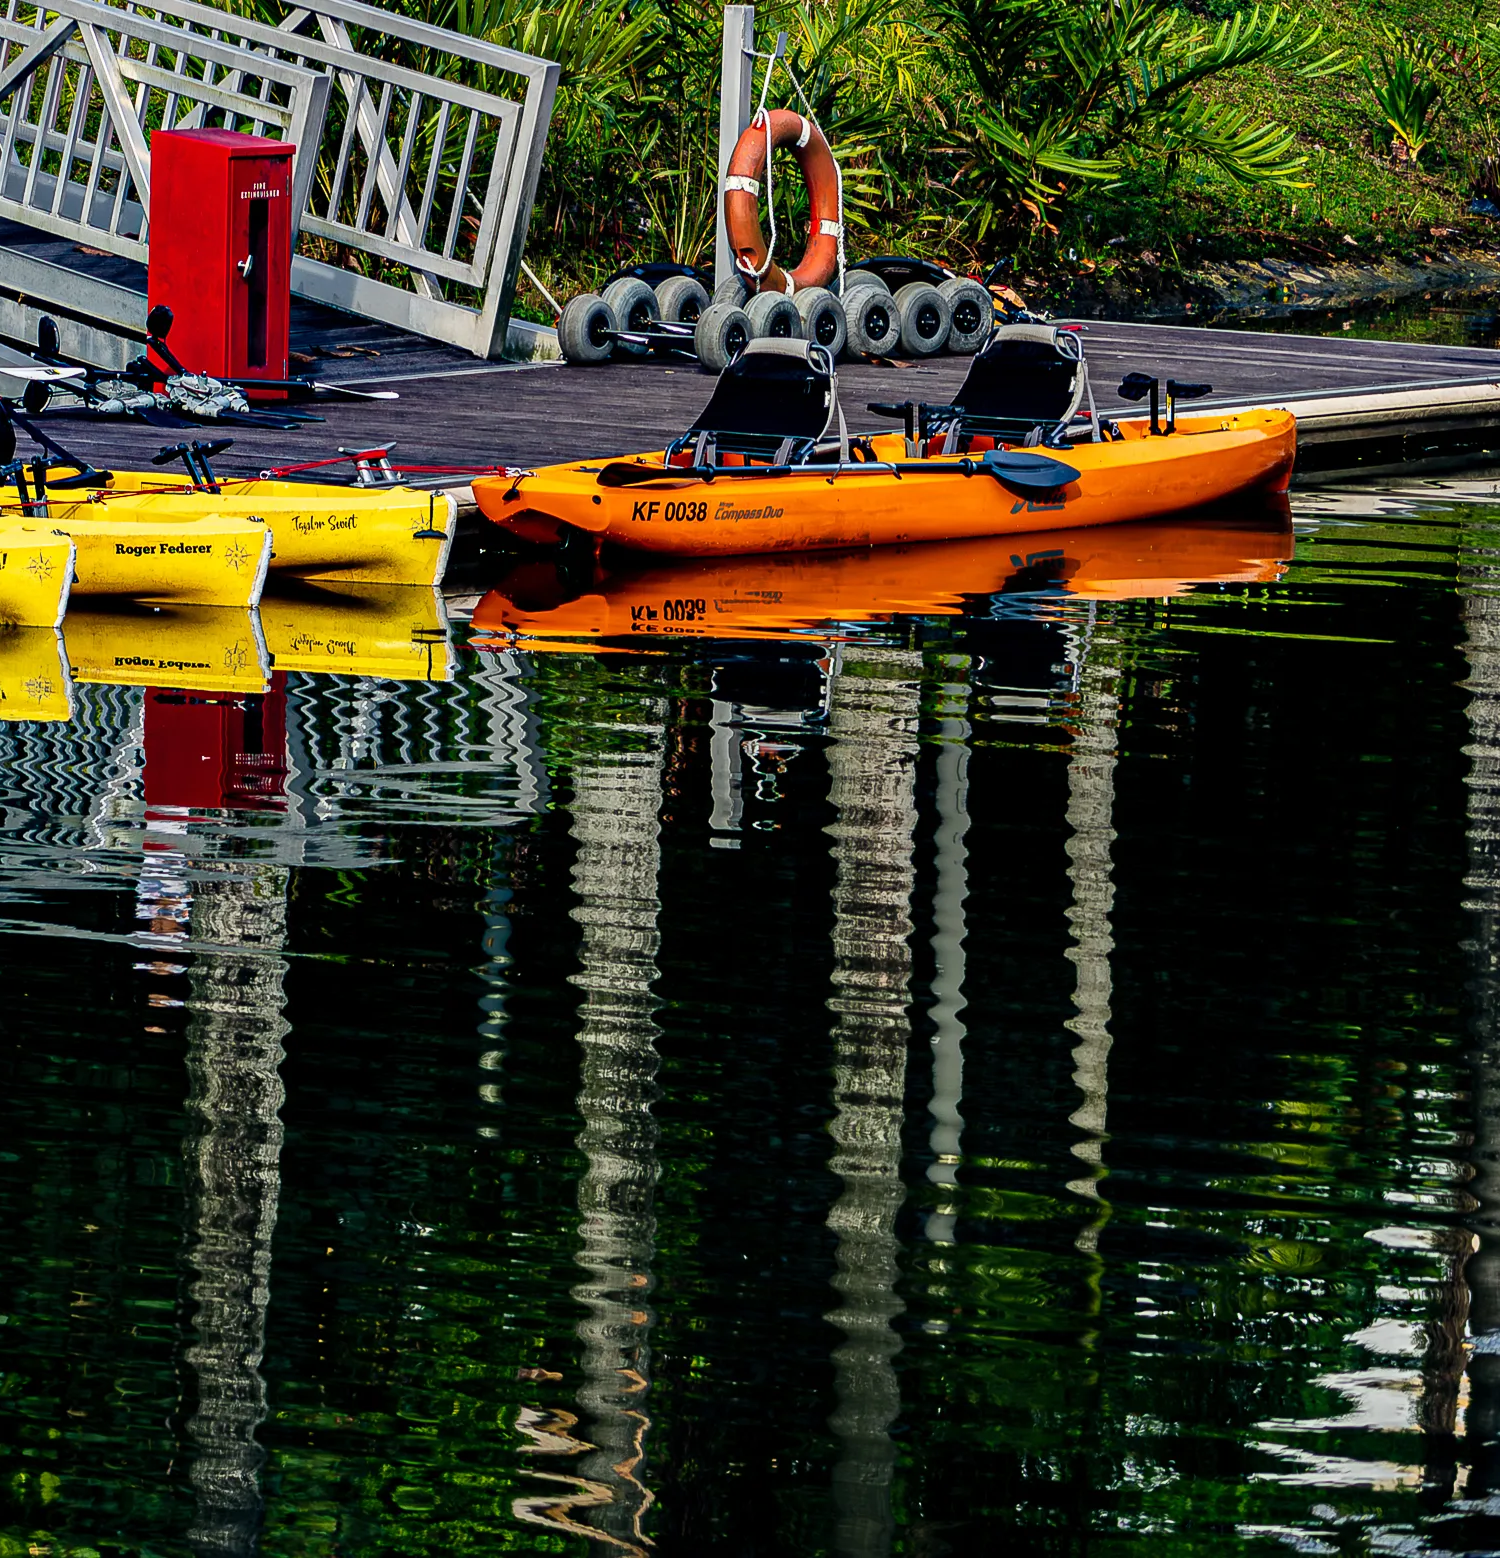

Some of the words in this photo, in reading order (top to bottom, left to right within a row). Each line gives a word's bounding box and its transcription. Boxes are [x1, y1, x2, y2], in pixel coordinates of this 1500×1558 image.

[253, 182, 266, 190] FIRE
[632, 501, 660, 521] KF
[664, 501, 708, 522] 0038
[714, 507, 761, 522] Compass
[762, 506, 784, 519] Duo
[291, 515, 325, 535] Taylor
[328, 514, 358, 531] Swift
[115, 543, 157, 556] Roger
[159, 542, 212, 554] Federer
